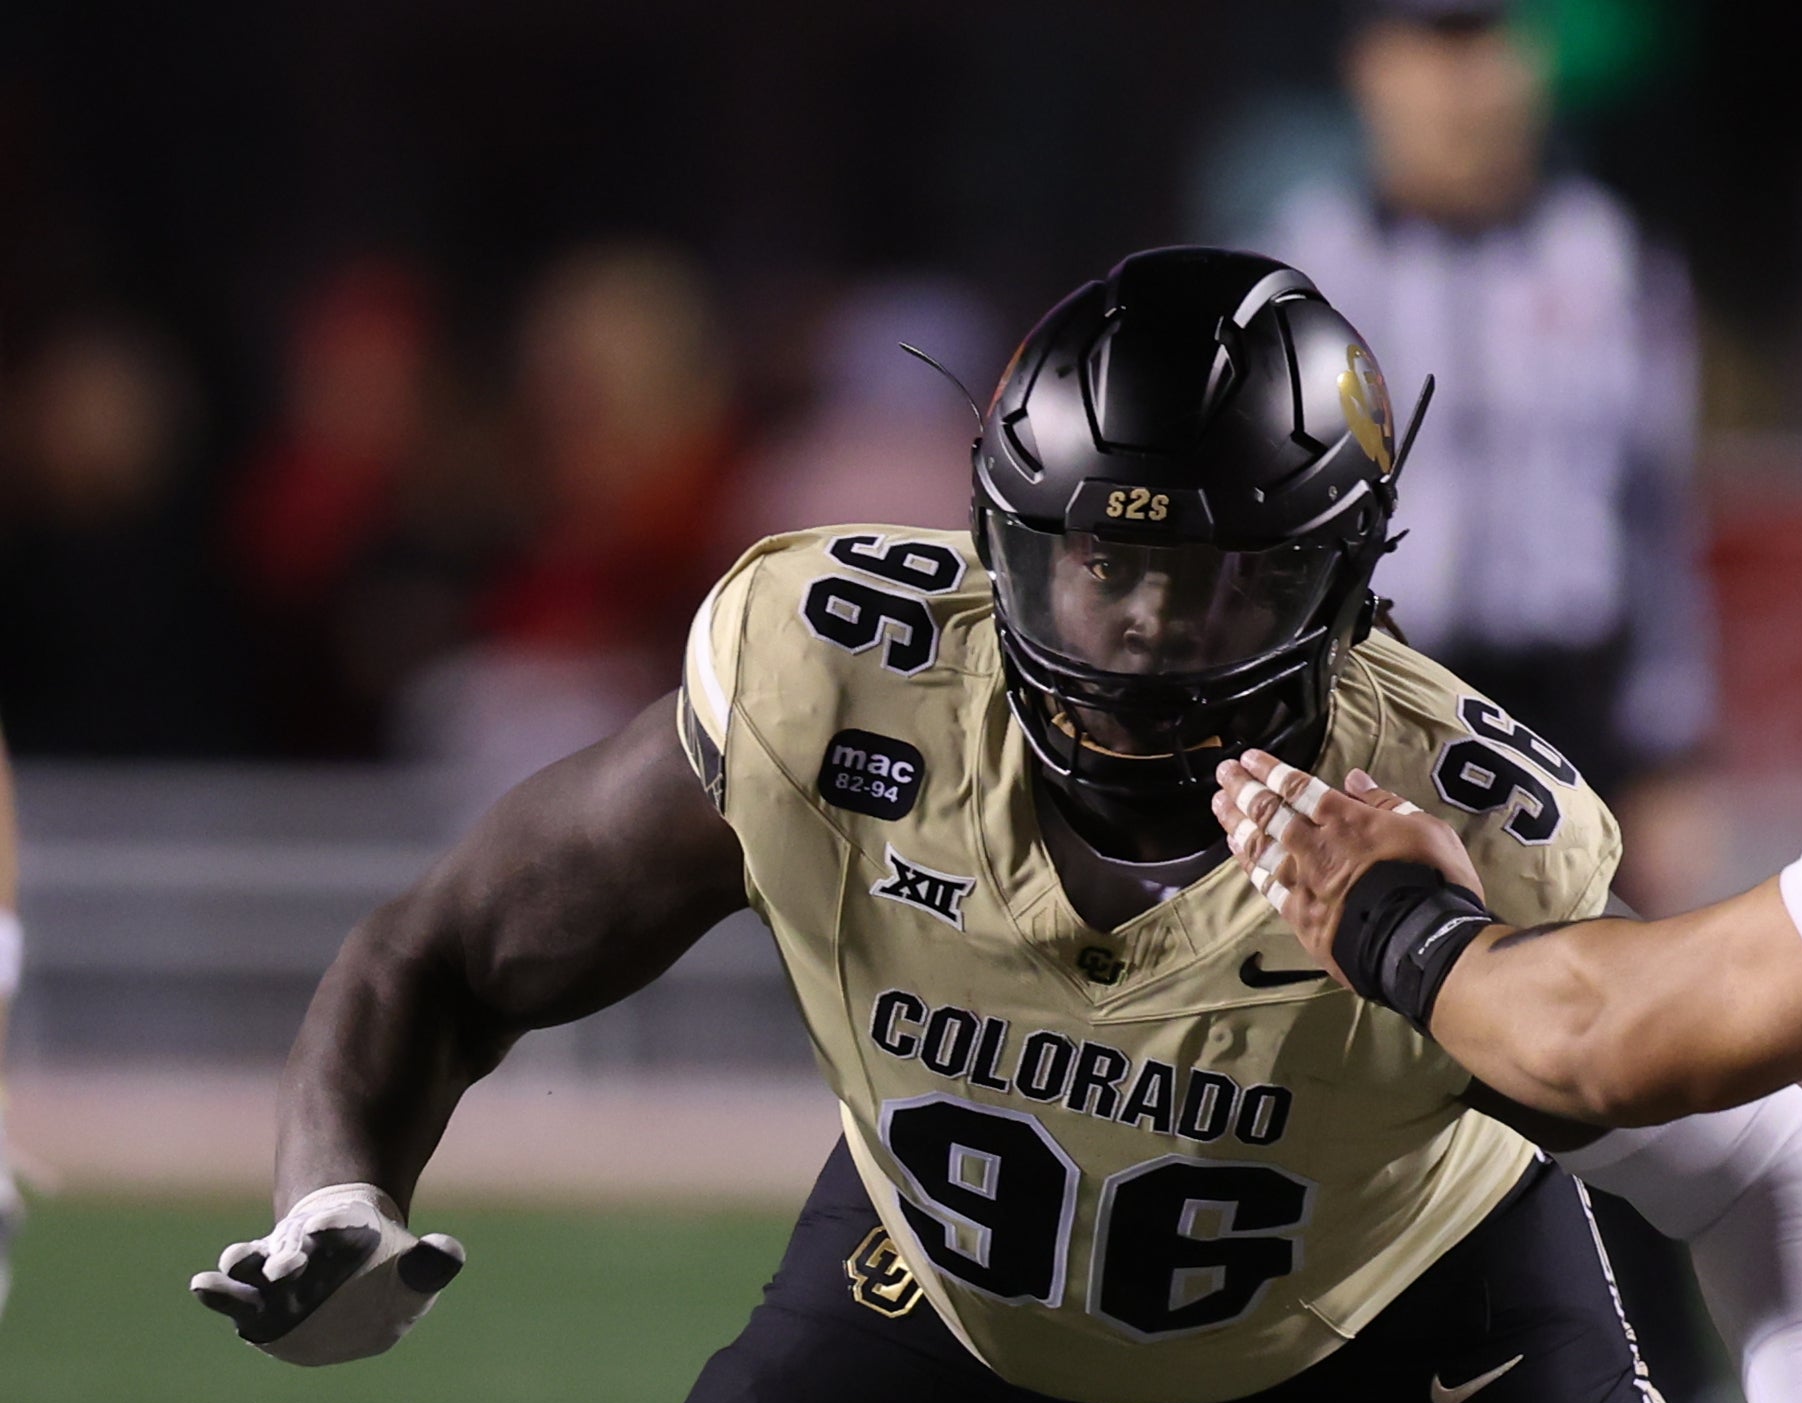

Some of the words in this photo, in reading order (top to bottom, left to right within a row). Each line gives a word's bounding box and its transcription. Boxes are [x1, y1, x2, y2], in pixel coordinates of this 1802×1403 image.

[798, 533, 968, 678] 96
[832, 744, 915, 784] mac
[835, 773, 899, 803] 82-94
[1430, 694, 1585, 848] 96
[871, 990, 1293, 1147] COLORADO
[879, 1091, 1319, 1344] 96
